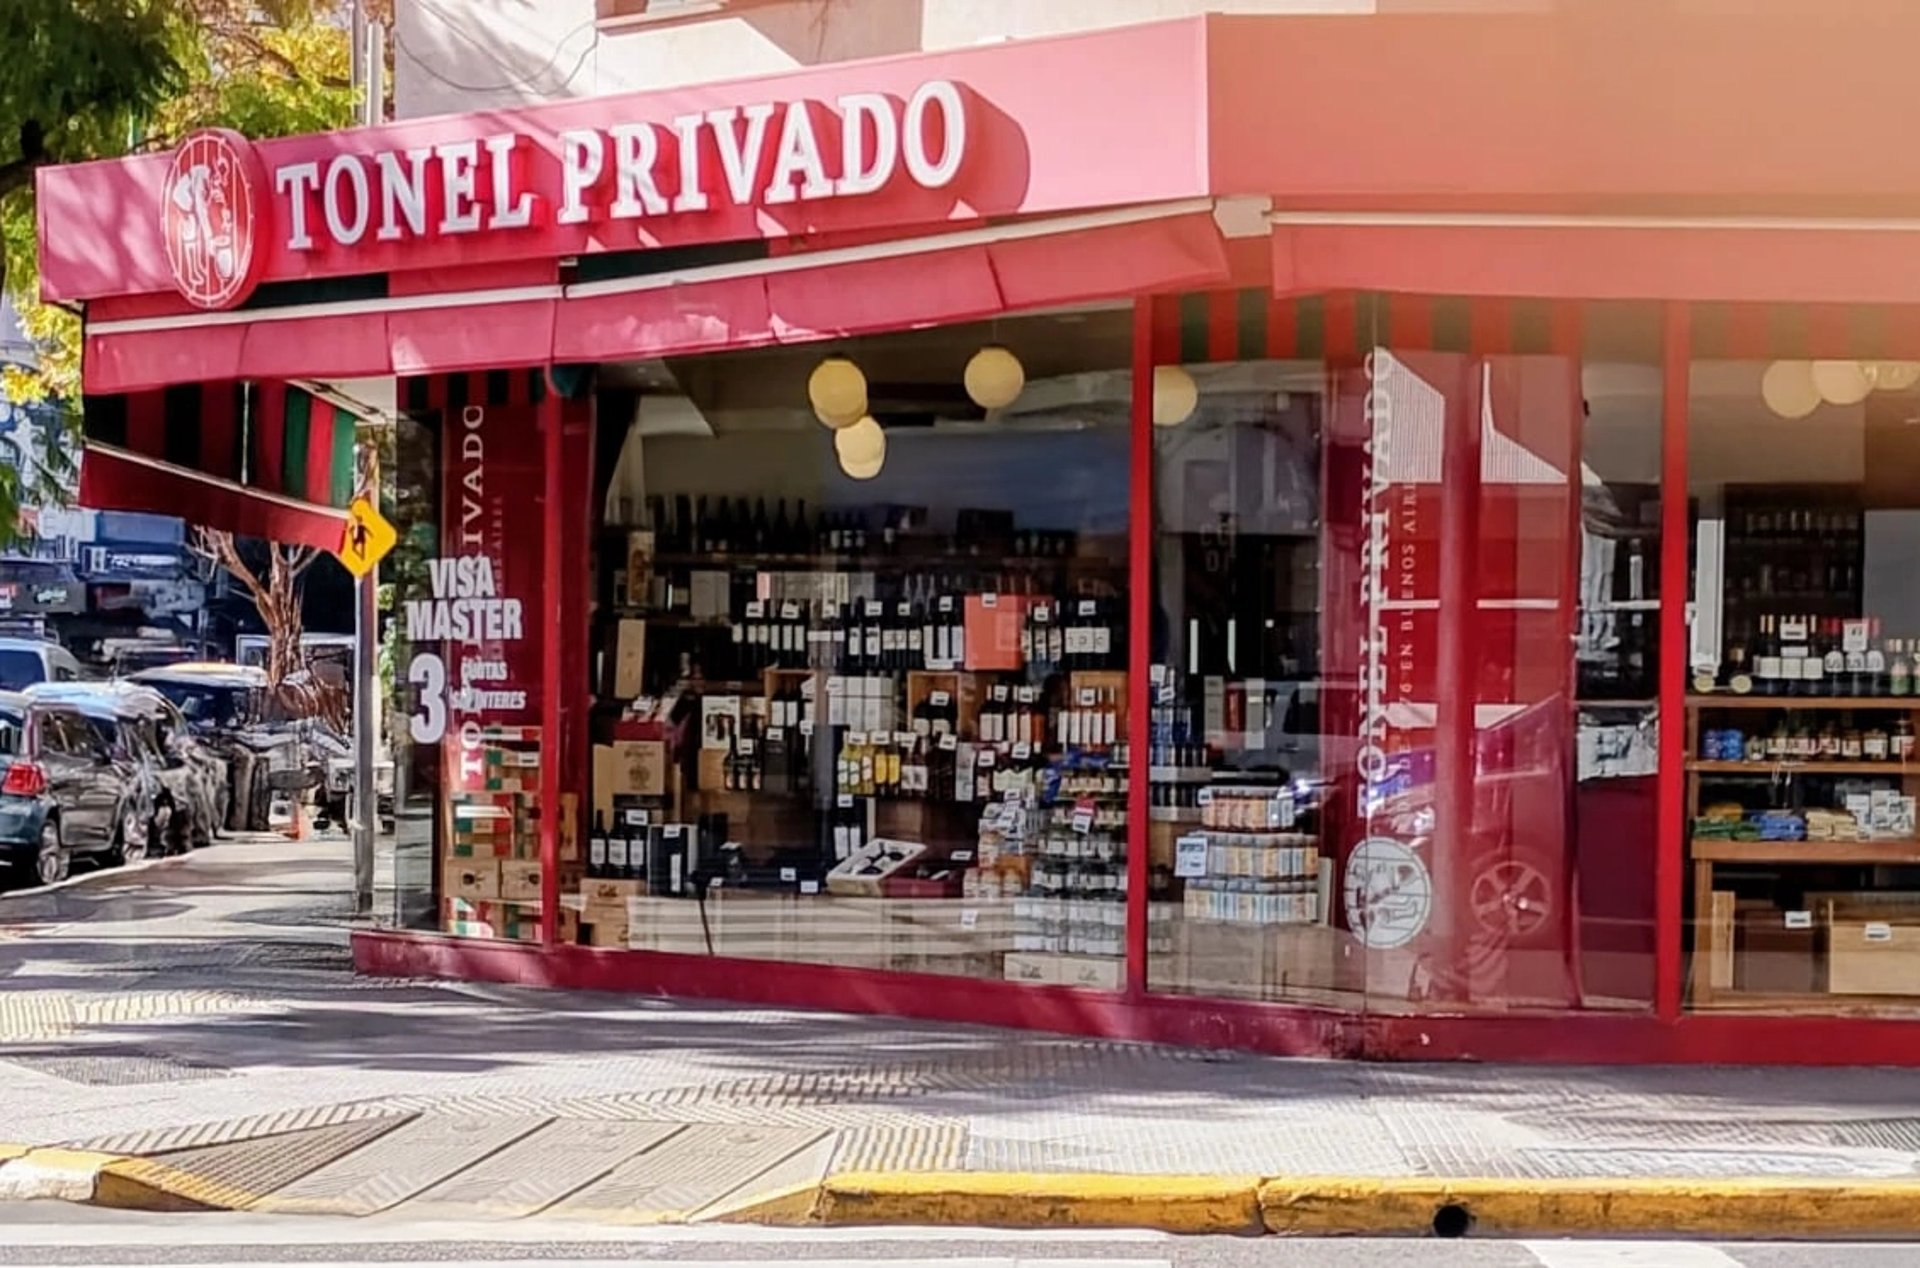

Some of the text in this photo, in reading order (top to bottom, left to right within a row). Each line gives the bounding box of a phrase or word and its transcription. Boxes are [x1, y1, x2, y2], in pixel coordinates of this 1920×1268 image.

[276, 80, 967, 251] TONEL PRIVADO
[428, 555, 496, 599] VISA
[406, 598, 523, 640] MASTER
[408, 652, 446, 744] 3
